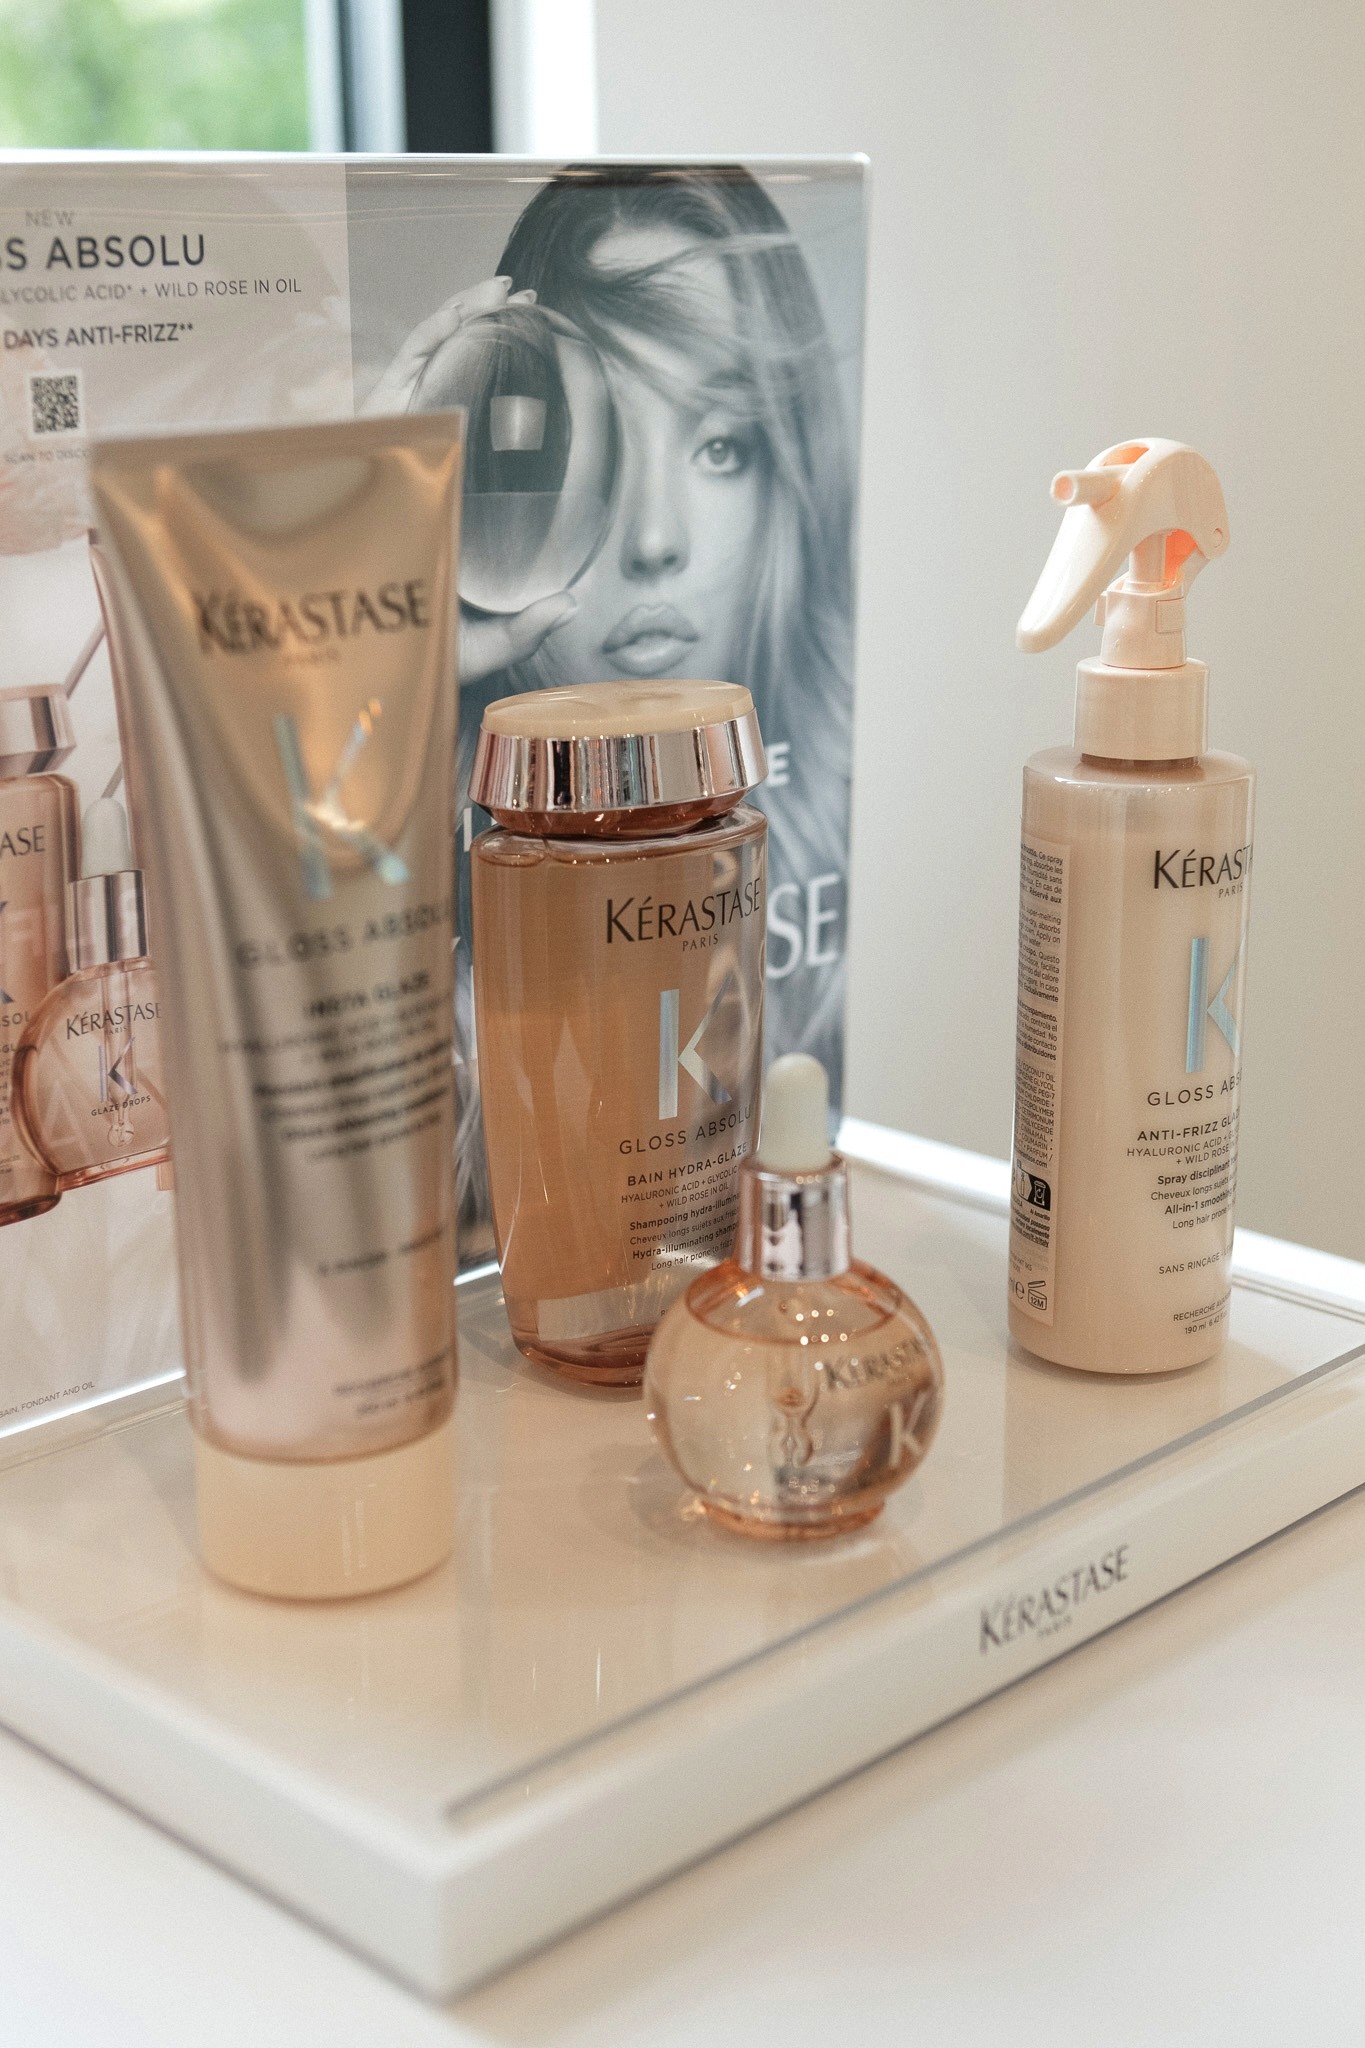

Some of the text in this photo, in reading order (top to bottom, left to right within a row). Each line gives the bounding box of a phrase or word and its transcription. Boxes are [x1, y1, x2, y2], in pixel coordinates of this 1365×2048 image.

[25, 209, 75, 227] NEW
[0, 233, 206, 271] S ABSOLU
[155, 281, 199, 299] WILD
[204, 279, 249, 296] ROSE
[253, 278, 271, 295] IN
[275, 277, 302, 295] OIL
[4, 327, 59, 350] DAYS
[1218, 882, 1244, 898] PARIS
[606, 876, 761, 945] KÉRASTASE
[682, 933, 720, 952] PARIS
[1045, 1073, 1056, 1083] OIL
[91, 1094, 151, 1117] GLAZE DROPS
[1147, 1084, 1214, 1106] GLOSS
[619, 1104, 751, 1154] GLOSS ABSOLU
[1137, 1120, 1219, 1142] ANTI-FRIZZ
[1127, 1142, 1201, 1157] HYALURONIC
[1202, 1136, 1223, 1150] ACID
[627, 1141, 748, 1187] BAIN HYDRA-GLAZE
[1184, 1151, 1210, 1165] WILD
[621, 1186, 680, 1204] HYALURONIC
[681, 1180, 700, 1193] ACID
[707, 1165, 738, 1185] GLYCOLIC
[1157, 1173, 1188, 1186] Spray
[666, 1195, 688, 1209] WILD
[689, 1188, 709, 1203] ROSE
[710, 1186, 718, 1196] IN
[718, 1181, 729, 1193] OIL
[1150, 1188, 1191, 1201] Cheveux
[1192, 1184, 1213, 1195] longs
[1164, 1200, 1199, 1216] All-in-1
[629, 1211, 689, 1231] Shampooing
[1172, 1216, 1194, 1230] Long
[629, 1233, 667, 1246] Cheveux
[668, 1225, 690, 1238] longs
[632, 1231, 714, 1260] Hydra-illuminating
[651, 1260, 673, 1271] Long
[674, 1254, 689, 1265] hair
[690, 1249, 711, 1264] prone
[1158, 1264, 1185, 1275] SANS
[1173, 1302, 1216, 1322] RECHERCHE
[1184, 1324, 1198, 1335] 190
[21, 1391, 61, 1411] FONDANT
[62, 1385, 81, 1398] AND
[82, 1380, 96, 1392] OIL
